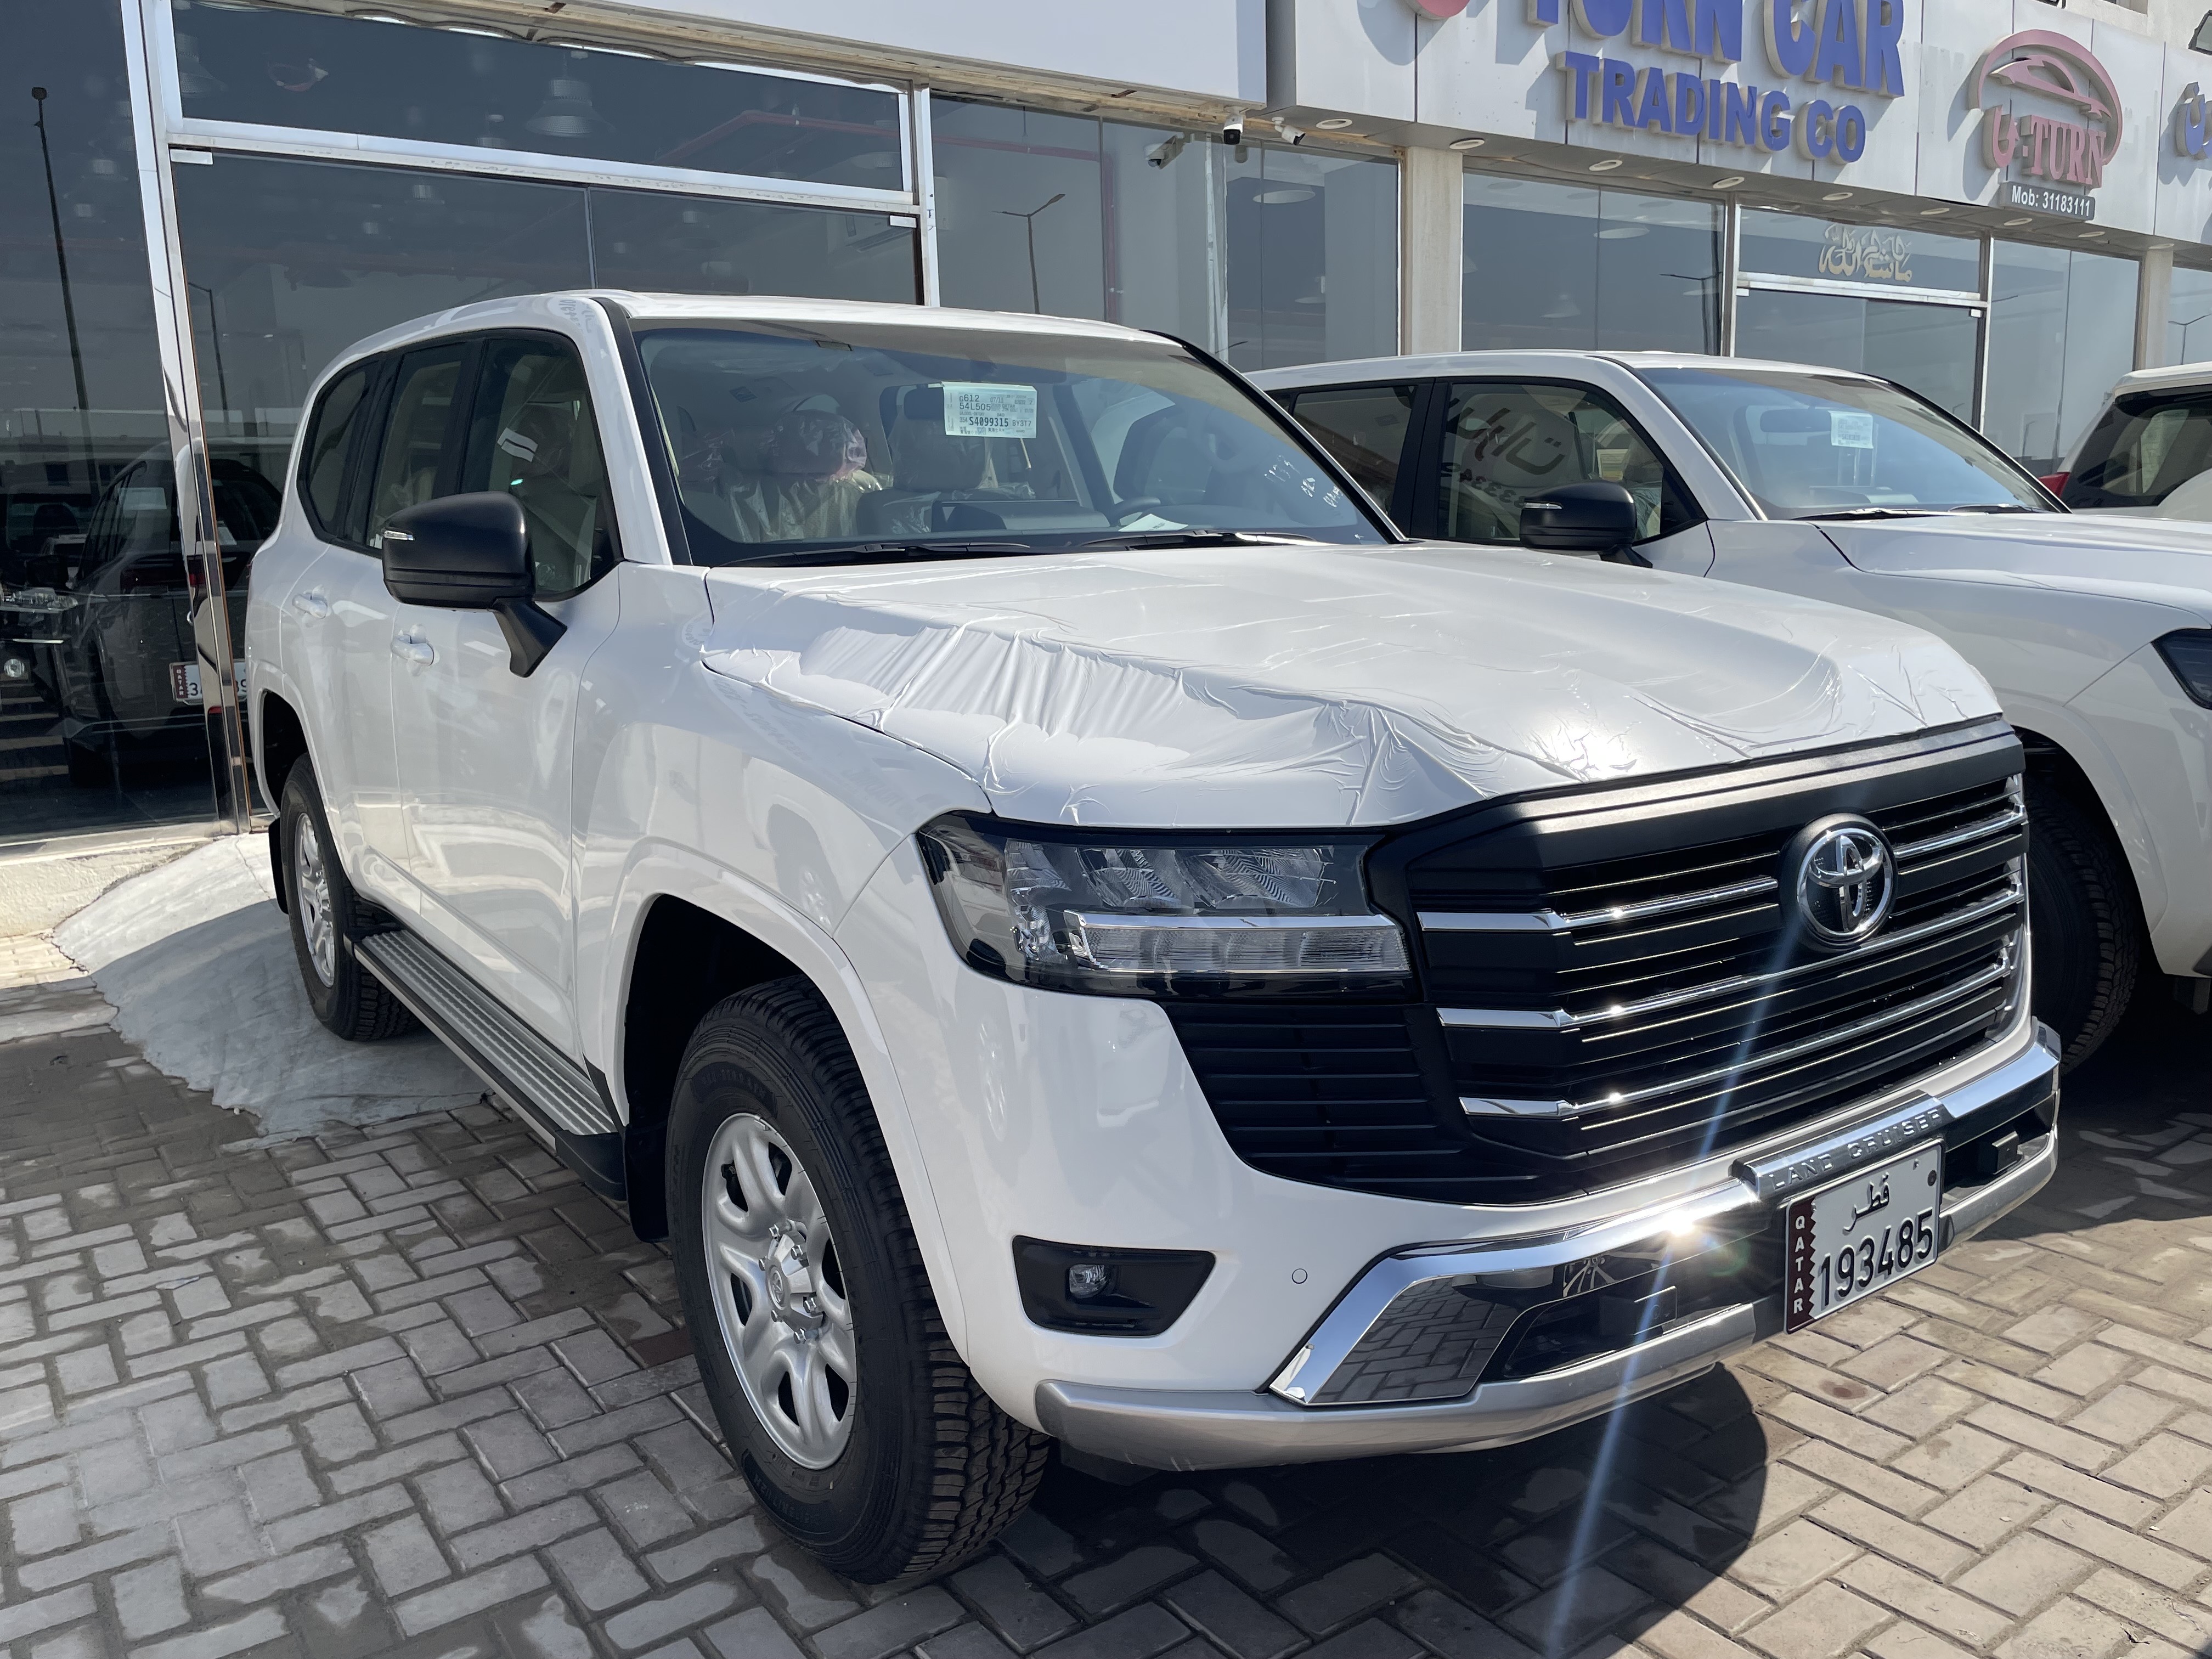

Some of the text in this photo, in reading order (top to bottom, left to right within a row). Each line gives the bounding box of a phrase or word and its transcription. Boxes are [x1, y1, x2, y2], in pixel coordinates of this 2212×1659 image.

[1768, 0, 1904, 97] CAR
[1562, 51, 1865, 163] TRADING CO
[2012, 185, 2090, 217] Mob: 31183111
[959, 394, 980, 402] G612
[960, 402, 991, 411] 54L505
[969, 416, 1009, 427] S4099315
[1769, 1108, 1940, 1190] LAND CRUISER
[1842, 1171, 1890, 1234] قطر
[1793, 1215, 1806, 1314] QATAR
[1819, 1207, 1933, 1307] 193485
